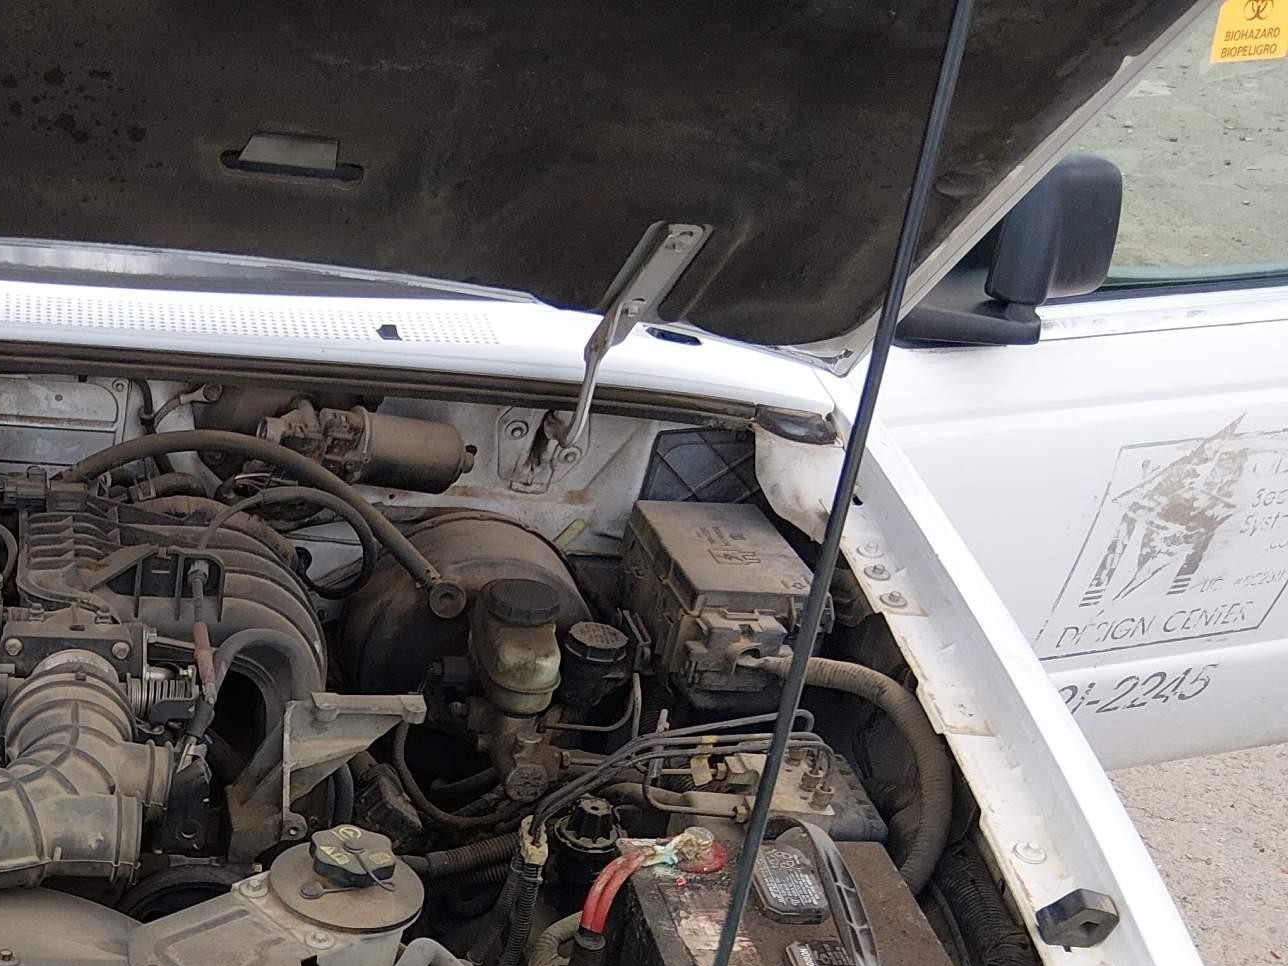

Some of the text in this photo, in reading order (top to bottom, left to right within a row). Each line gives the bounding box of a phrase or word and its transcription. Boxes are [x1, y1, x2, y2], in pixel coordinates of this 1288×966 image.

[1224, 27, 1281, 42] BIOHAZARD
[1220, 43, 1277, 58] BIOPELIGRO
[1163, 601, 1253, 633] CENTER
